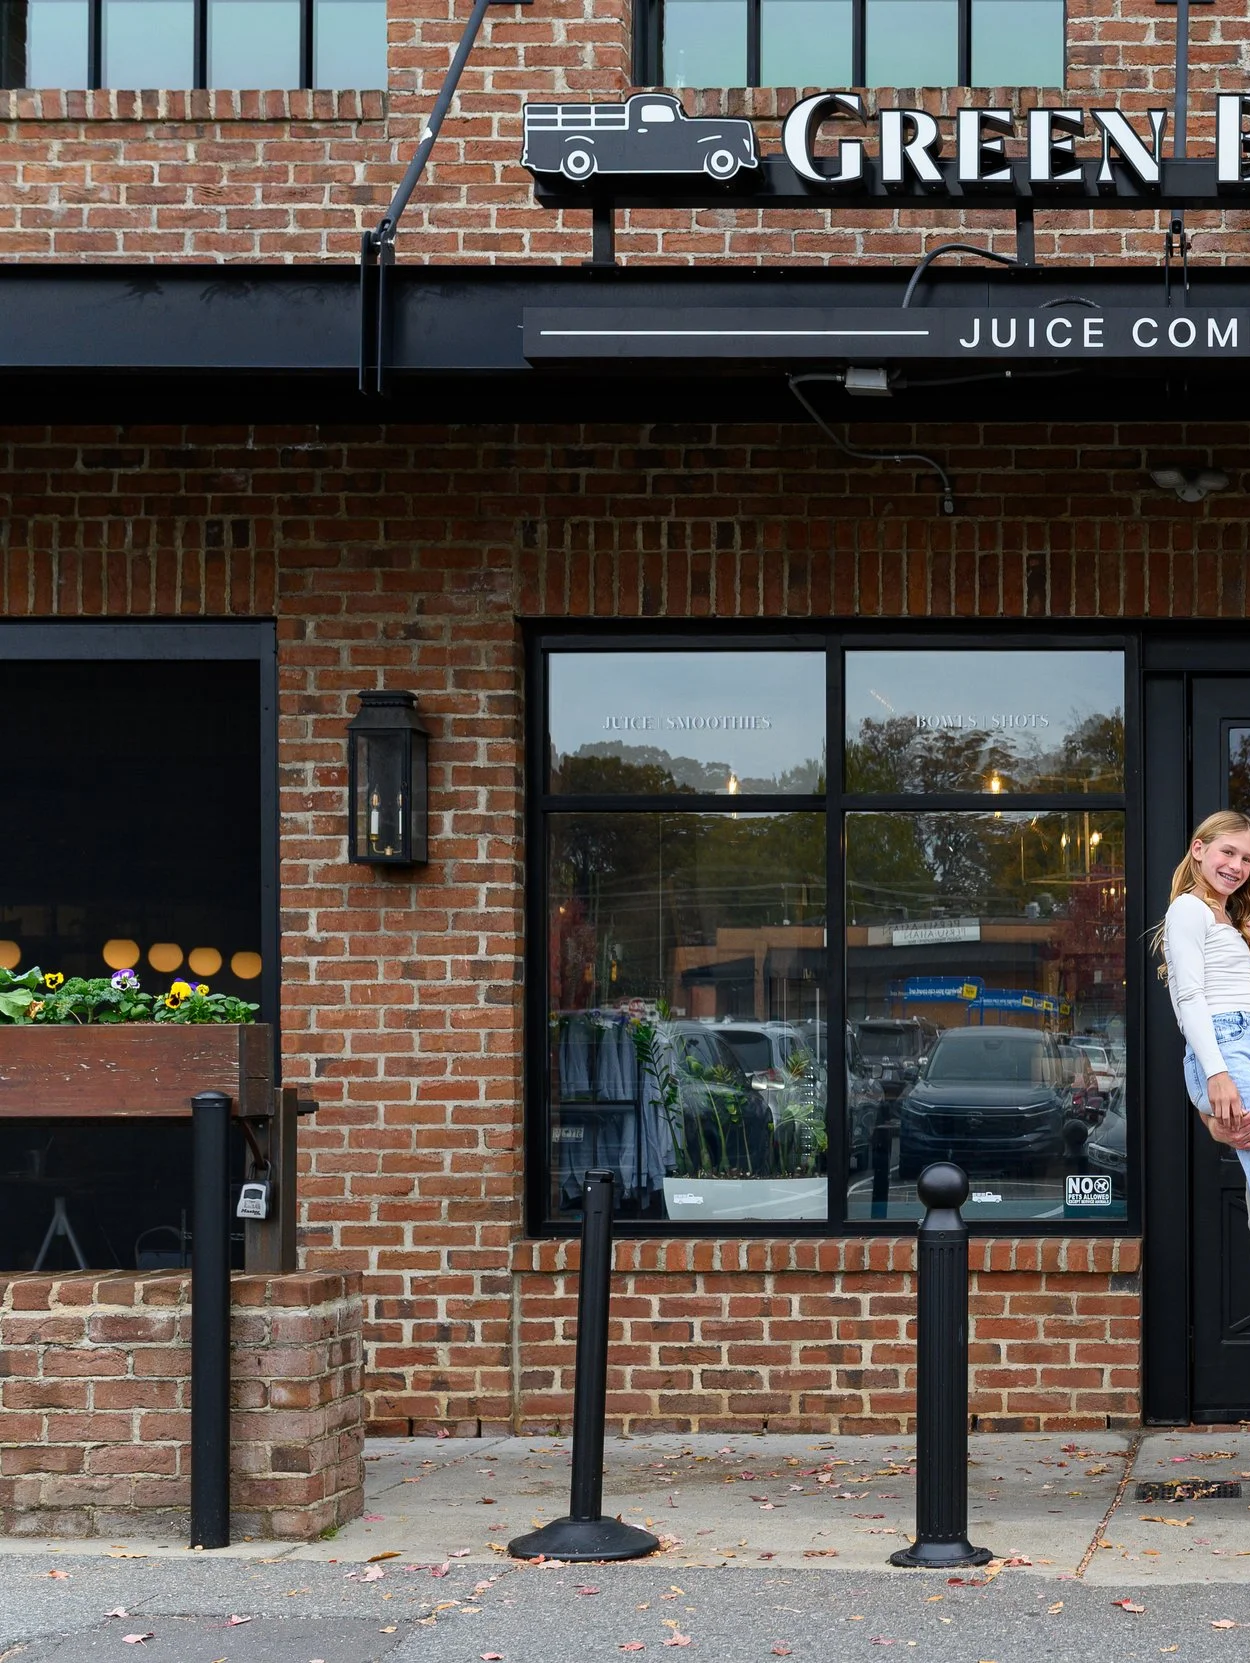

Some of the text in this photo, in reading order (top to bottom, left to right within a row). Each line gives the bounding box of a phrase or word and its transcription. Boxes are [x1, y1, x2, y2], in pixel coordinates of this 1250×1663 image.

[781, 92, 1167, 190] GREEN
[959, 316, 1106, 349] JUICE
[602, 715, 773, 730] JUICE SMOOTHIES
[916, 713, 1050, 729] BOWLS SHOTS
[1068, 1177, 1093, 1194] NO
